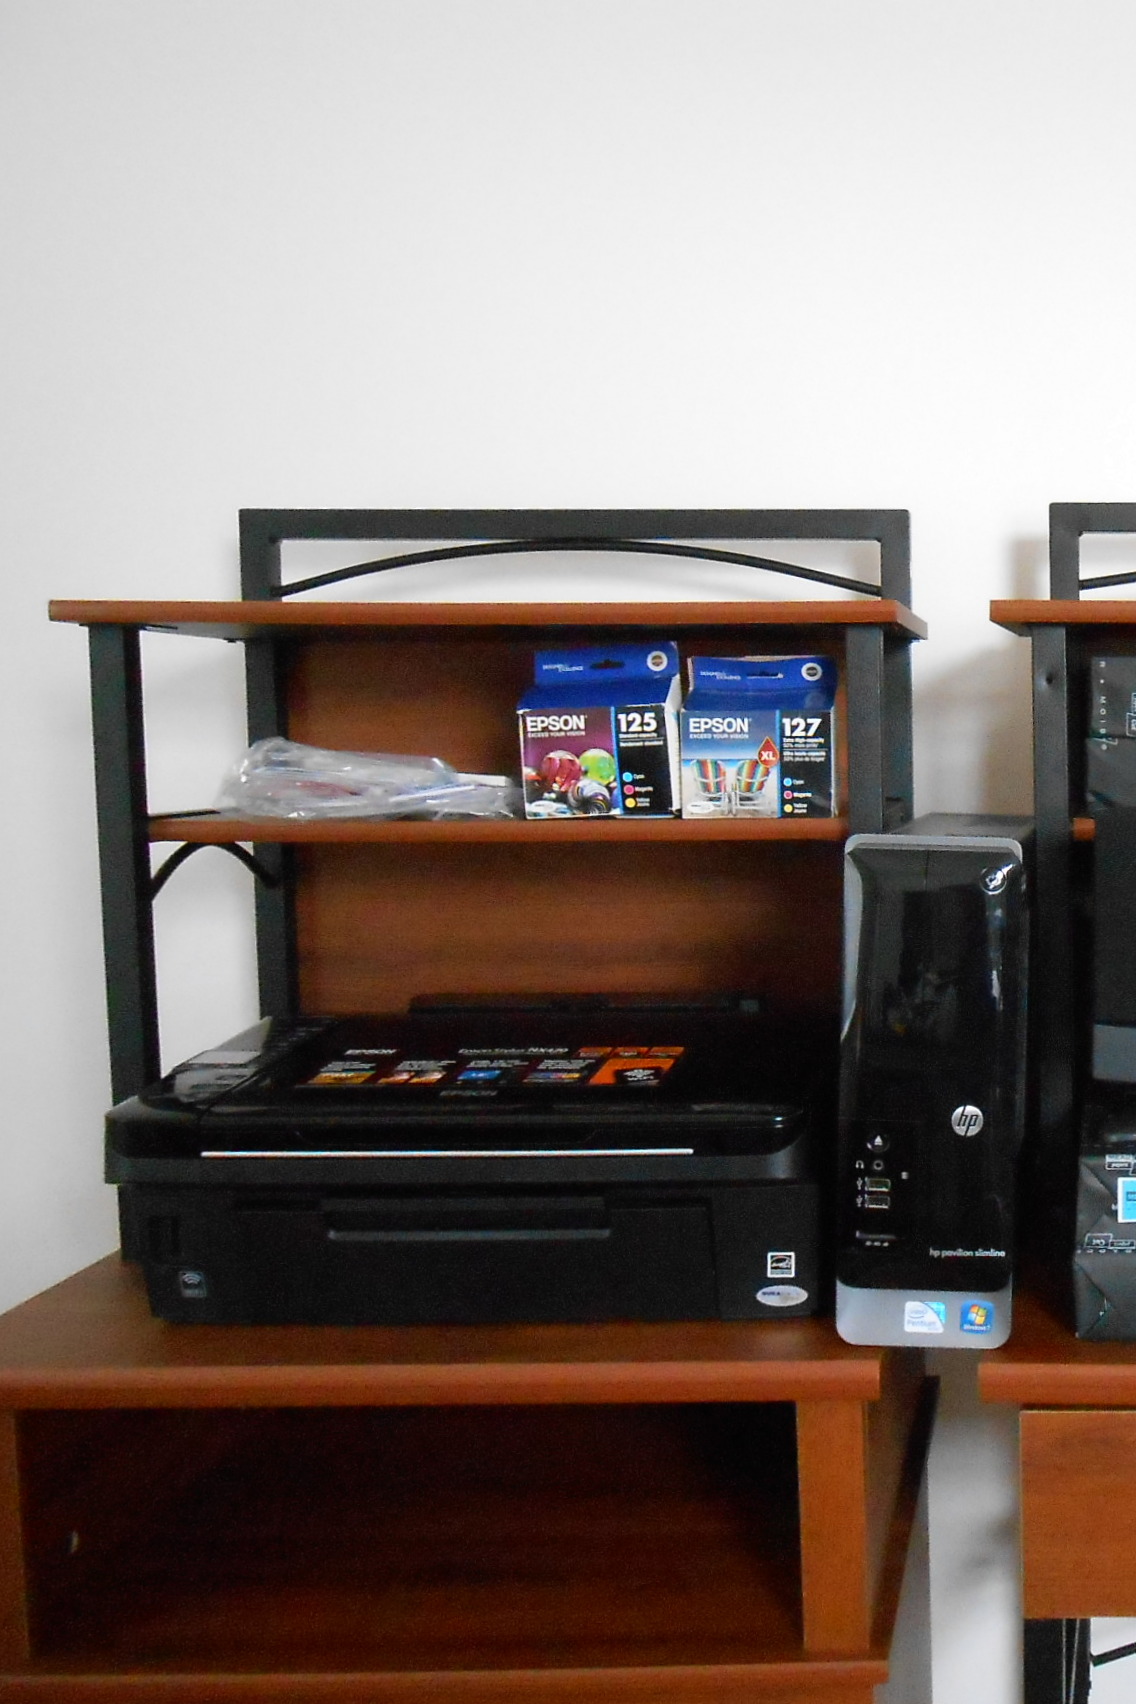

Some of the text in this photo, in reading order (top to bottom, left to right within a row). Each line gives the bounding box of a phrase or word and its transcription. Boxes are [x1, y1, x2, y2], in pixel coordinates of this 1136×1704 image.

[526, 715, 585, 731] EPSON
[617, 712, 657, 732] 125
[689, 718, 749, 733] EPSON
[782, 717, 822, 736] 127
[761, 750, 776, 760] XL
[956, 1106, 980, 1137] hp
[929, 1247, 1006, 1258] hp pavilion slimline
[963, 1323, 986, 1331] Windows
